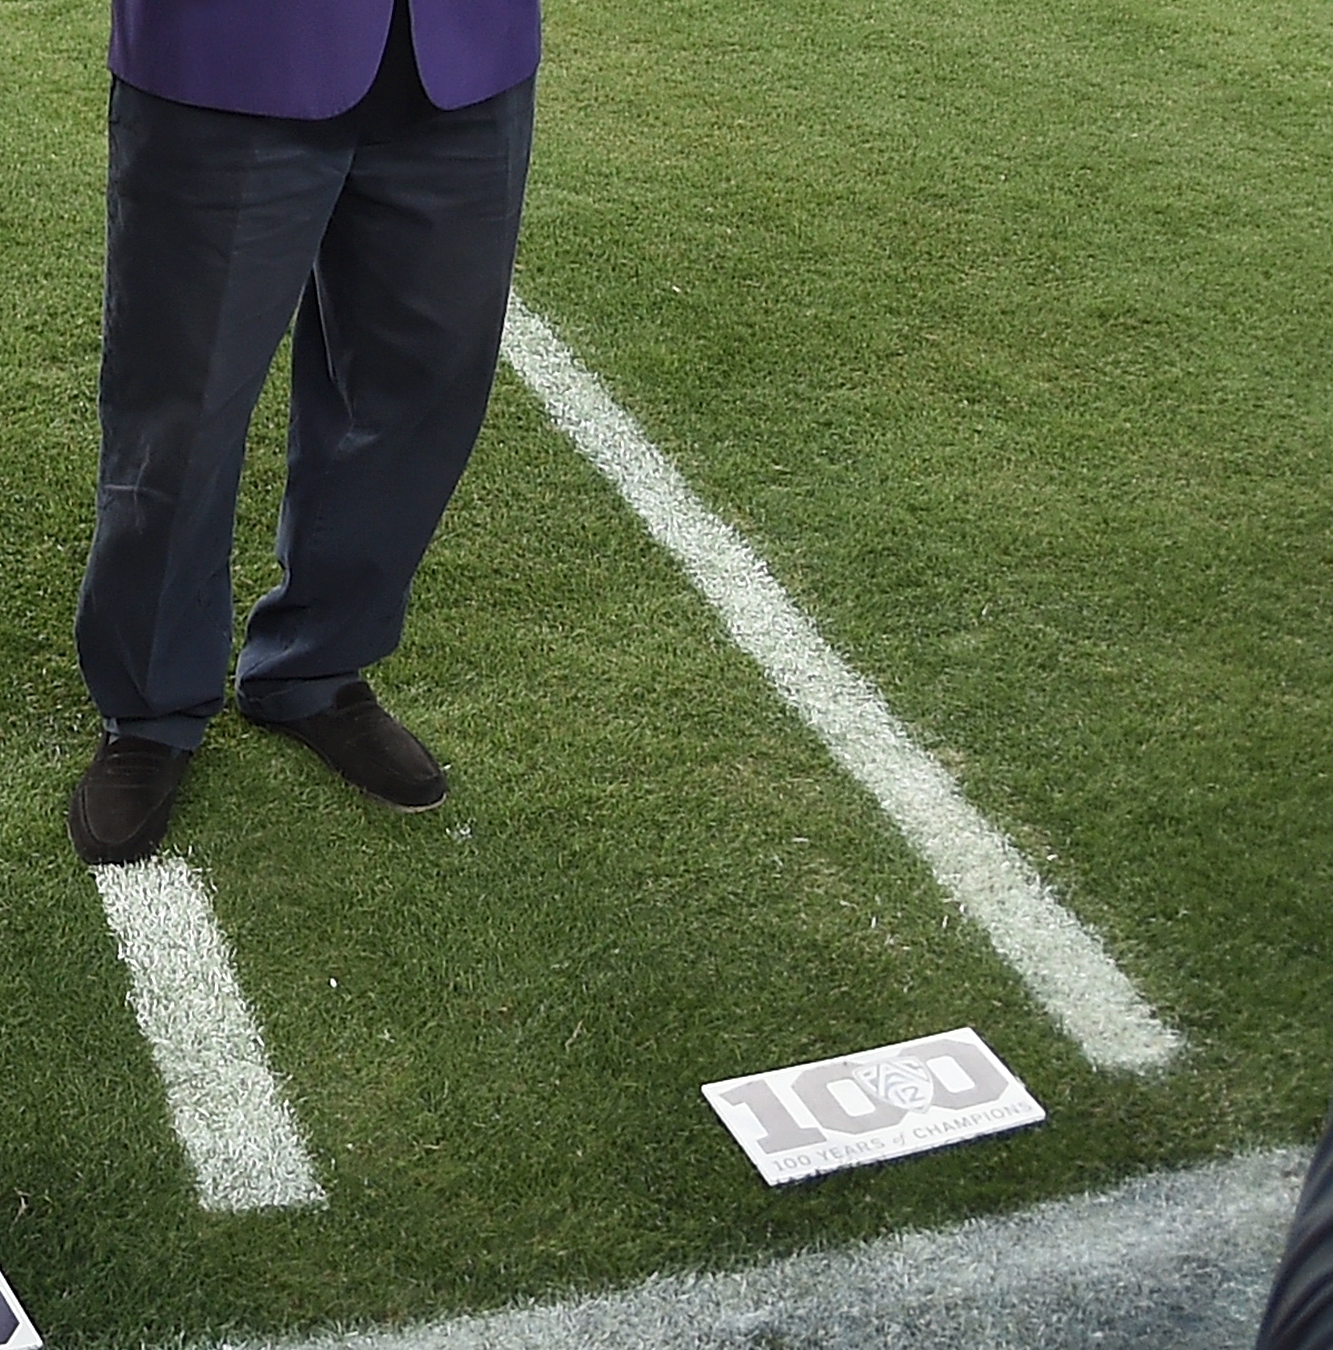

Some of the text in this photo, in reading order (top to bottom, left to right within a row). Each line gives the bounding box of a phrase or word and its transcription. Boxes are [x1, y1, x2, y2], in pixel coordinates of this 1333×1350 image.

[718, 1038, 1010, 1155] 100
[772, 1155, 812, 1173] 100
[819, 1137, 887, 1165] YEARS
[912, 1101, 1033, 1140] CHAMPIONS
